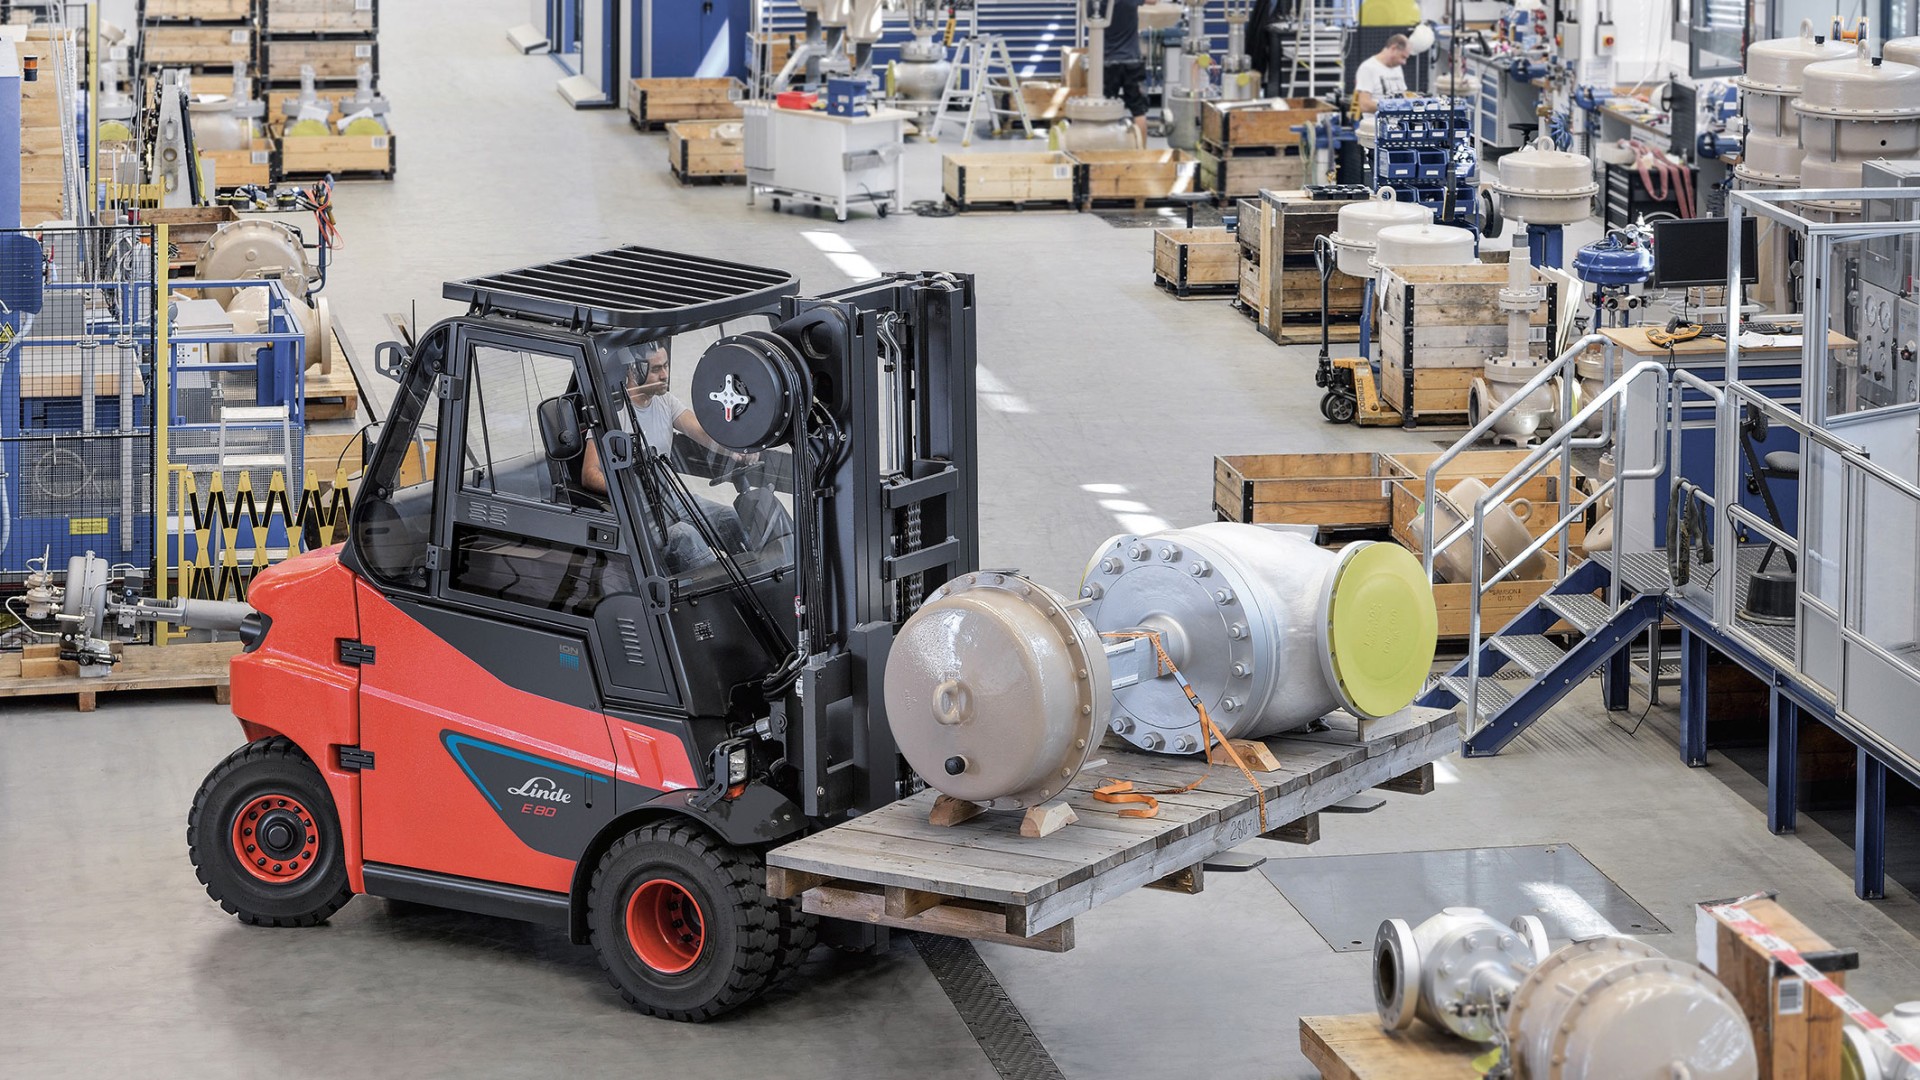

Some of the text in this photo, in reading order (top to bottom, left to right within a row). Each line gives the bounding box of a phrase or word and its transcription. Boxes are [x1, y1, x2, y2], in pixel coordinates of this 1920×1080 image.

[559, 644, 579, 656] ION
[507, 776, 571, 804] Linde
[521, 803, 557, 817] E 80
